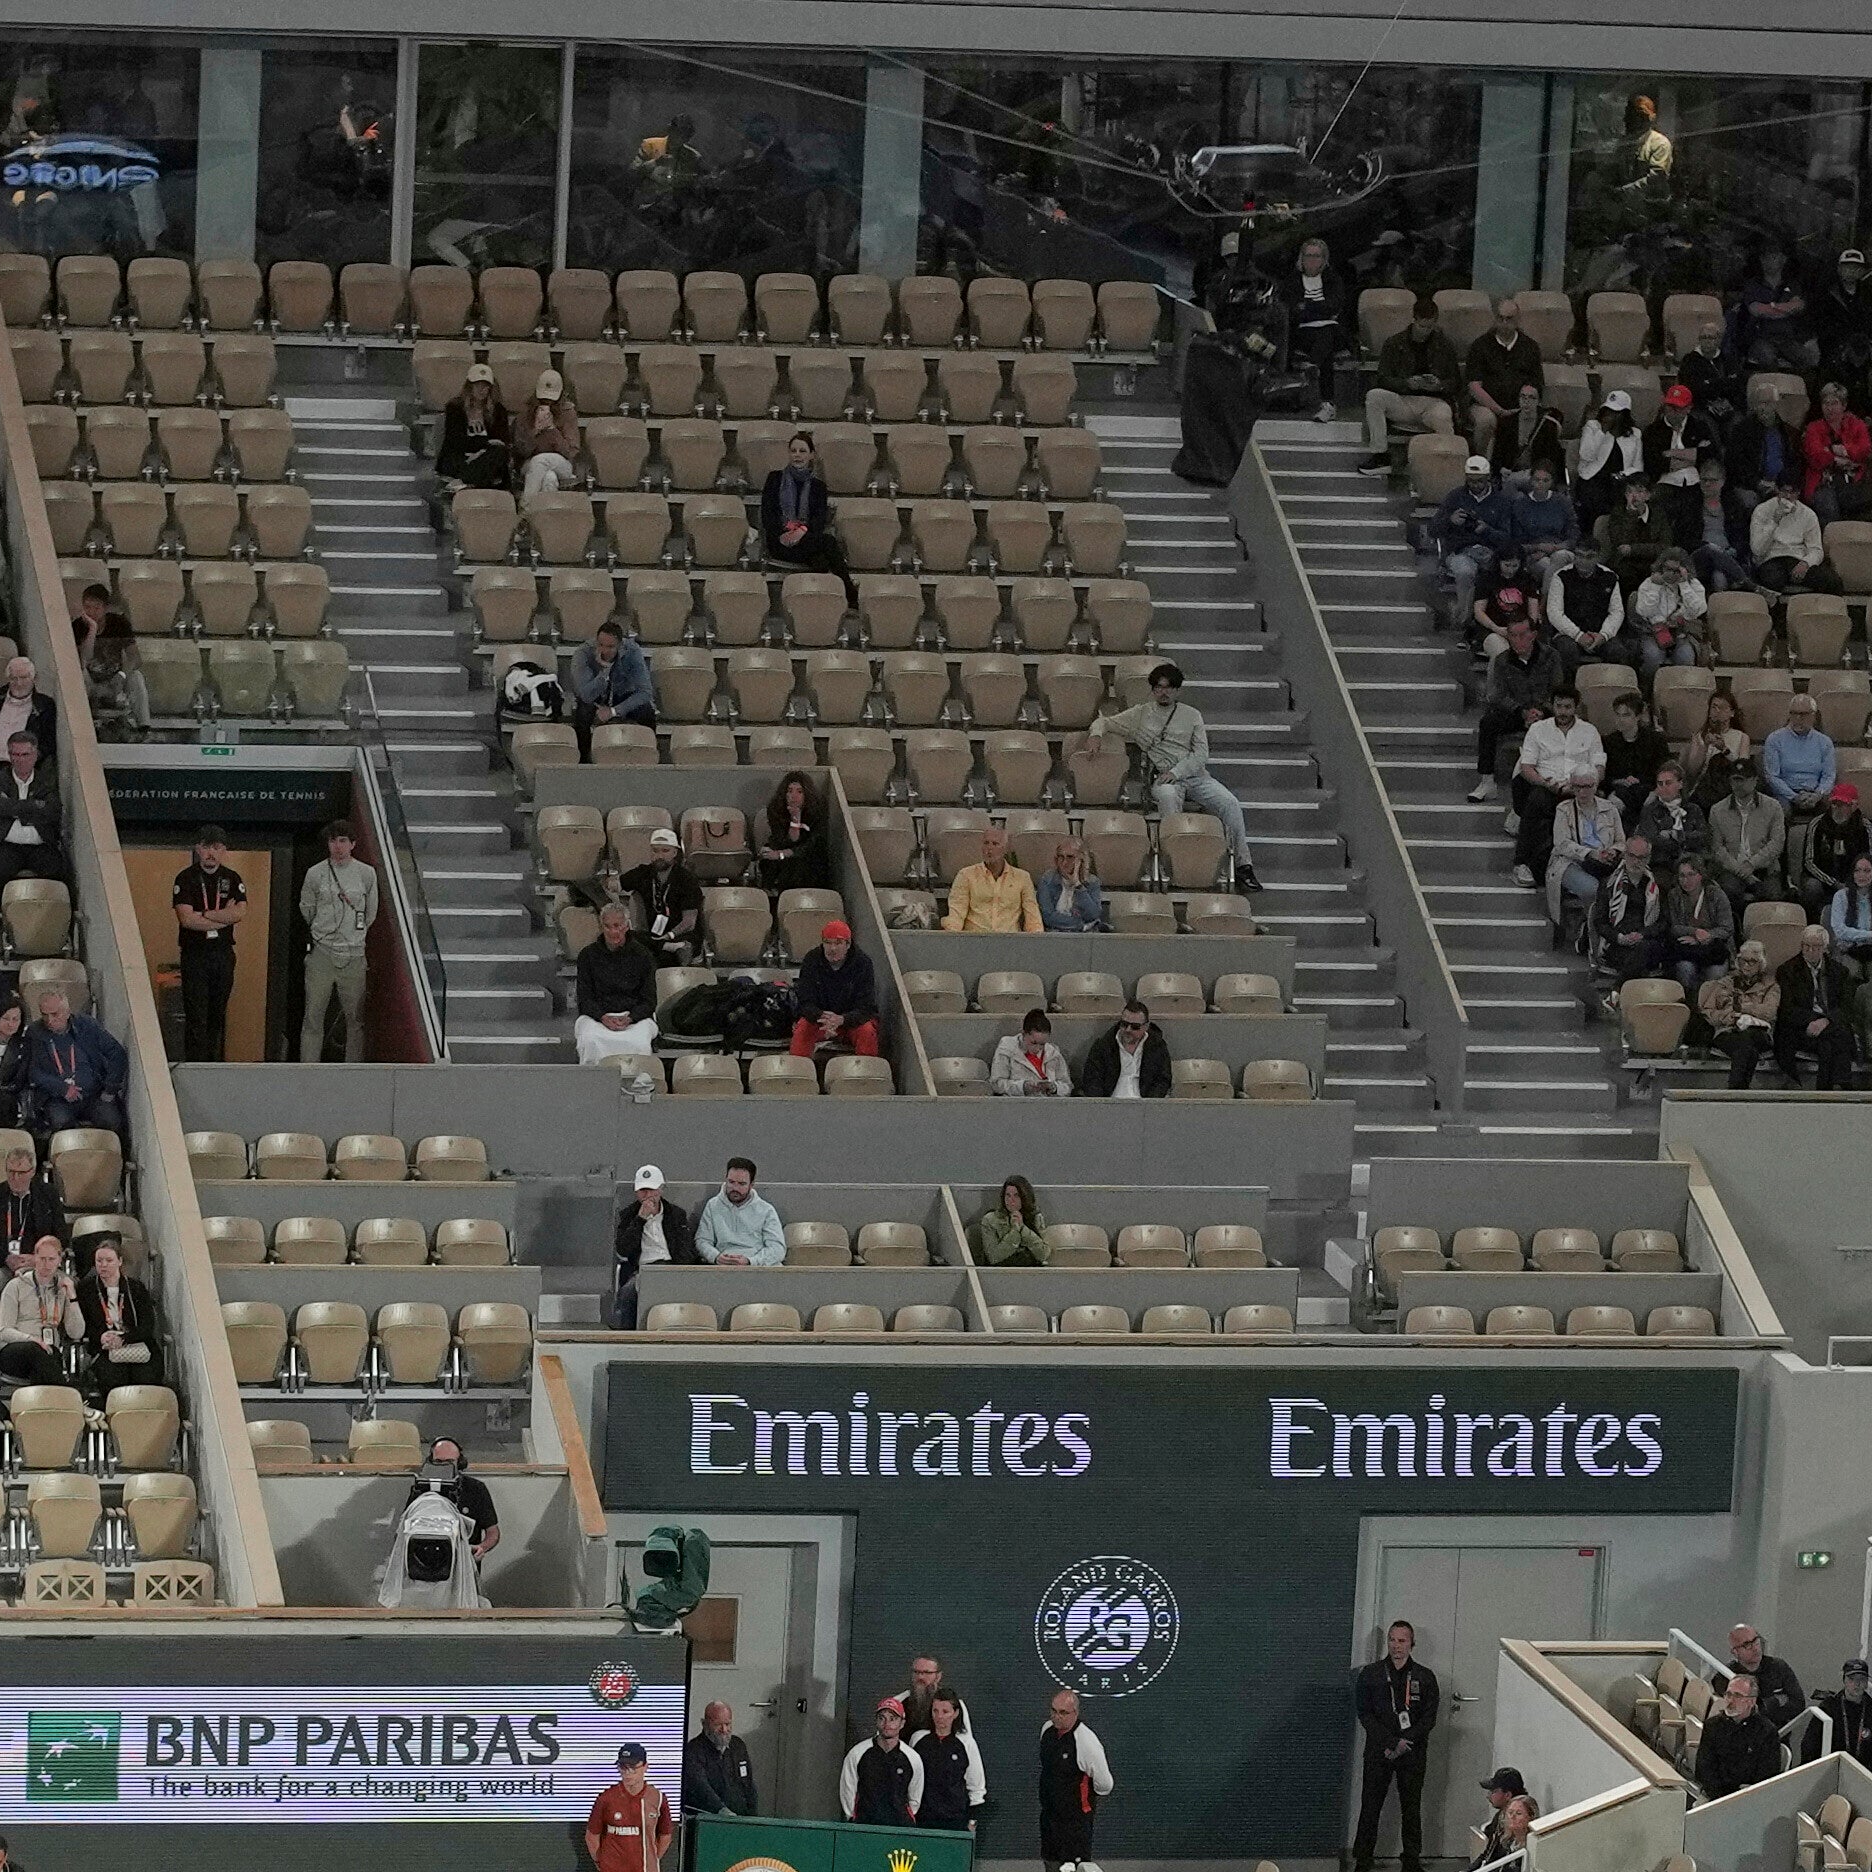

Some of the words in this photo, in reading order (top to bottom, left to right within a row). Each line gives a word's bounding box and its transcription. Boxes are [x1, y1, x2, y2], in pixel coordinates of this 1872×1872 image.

[259, 791, 276, 800] DE
[280, 791, 326, 801] TENNIS
[689, 1391, 1092, 1477] Emirates
[1268, 1393, 1664, 1479] Emirates
[145, 1714, 276, 1767] BNP
[296, 1713, 561, 1767] PARIBAS
[148, 1775, 192, 1797] The
[204, 1774, 266, 1797] bank
[274, 1774, 315, 1803] for
[323, 1780, 338, 1797] a
[350, 1774, 469, 1803] changing
[480, 1773, 555, 1797] world
